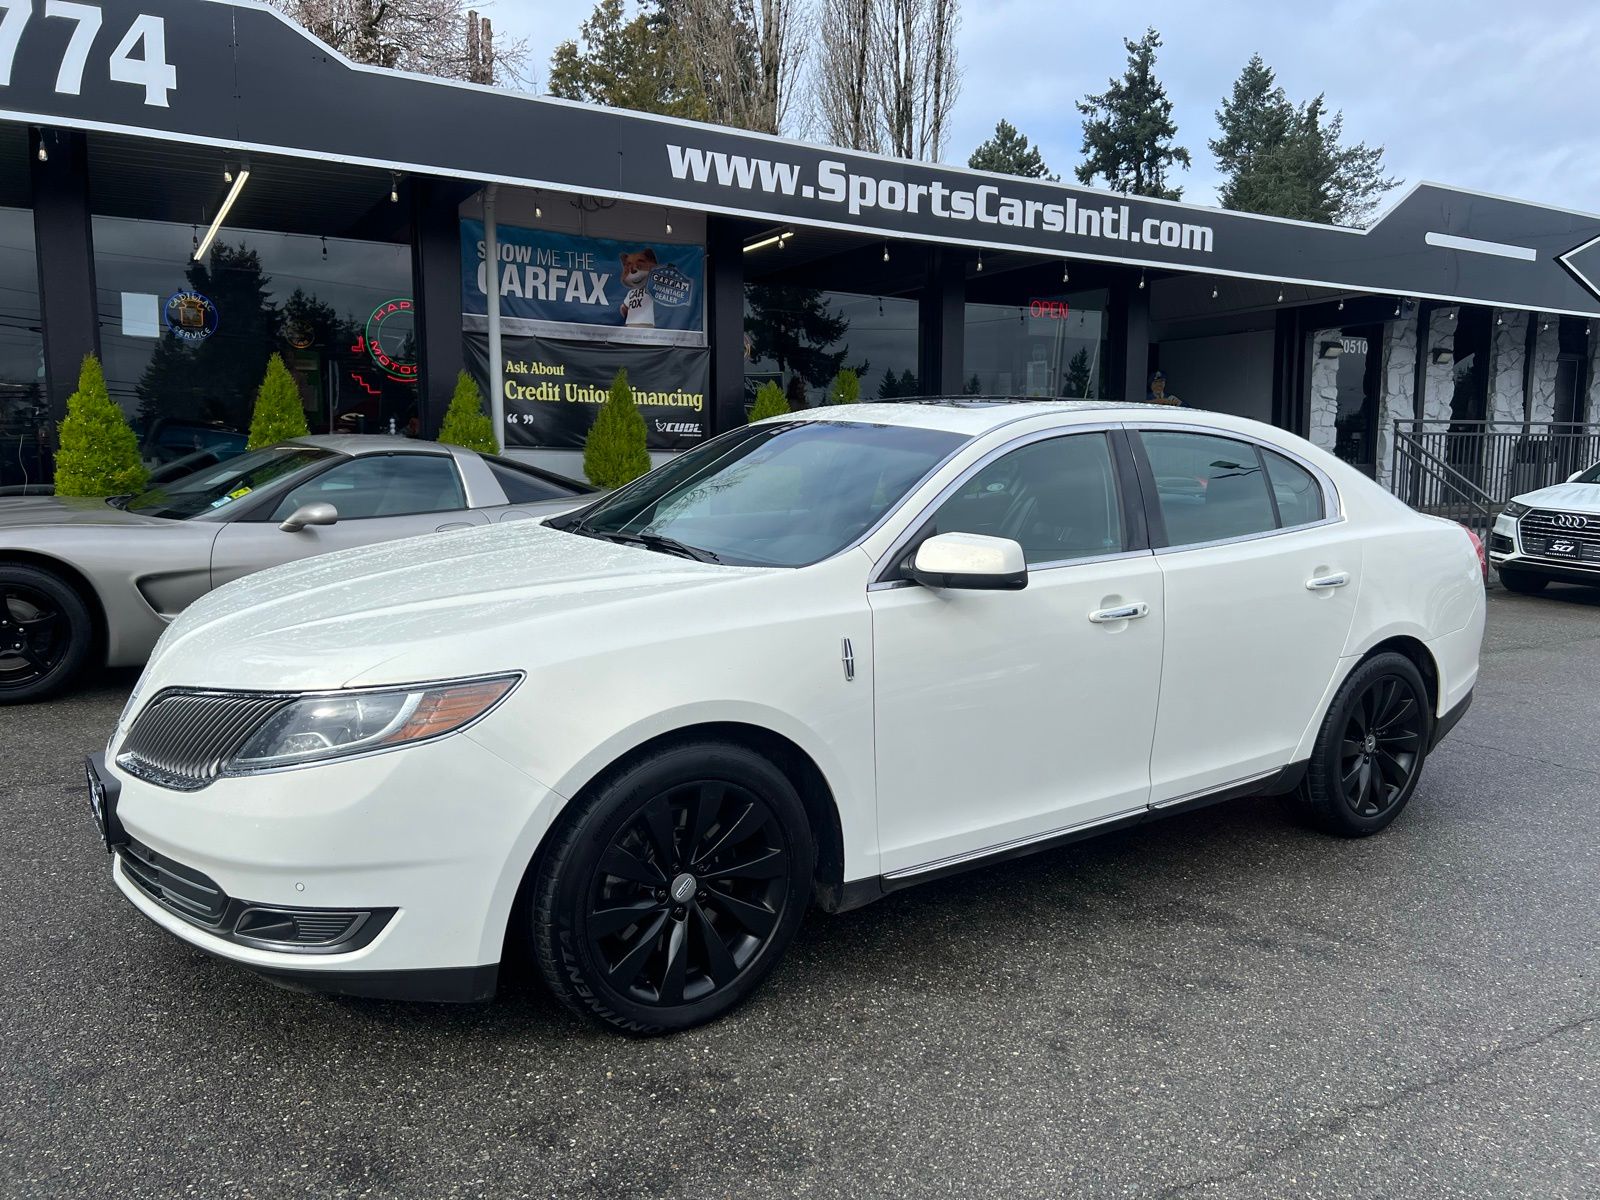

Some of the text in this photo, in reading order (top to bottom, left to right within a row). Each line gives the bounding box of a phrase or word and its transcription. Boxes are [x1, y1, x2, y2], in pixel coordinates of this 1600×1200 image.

[666, 144, 1214, 253] www.SportsCarsIntl.com
[477, 240, 595, 271] SOW ME THE
[653, 273, 689, 291] CARFAX
[629, 288, 644, 300] CAR
[653, 284, 685, 299] ADVANTAGE
[655, 293, 677, 304] DEALER
[168, 292, 214, 312] CADILLAC
[629, 299, 643, 309] FOX
[1030, 299, 1069, 321] OPEN
[173, 325, 212, 339] SERVICE
[505, 361, 565, 376] Ask About
[504, 380, 560, 402] Credit
[629, 386, 704, 411] inancing
